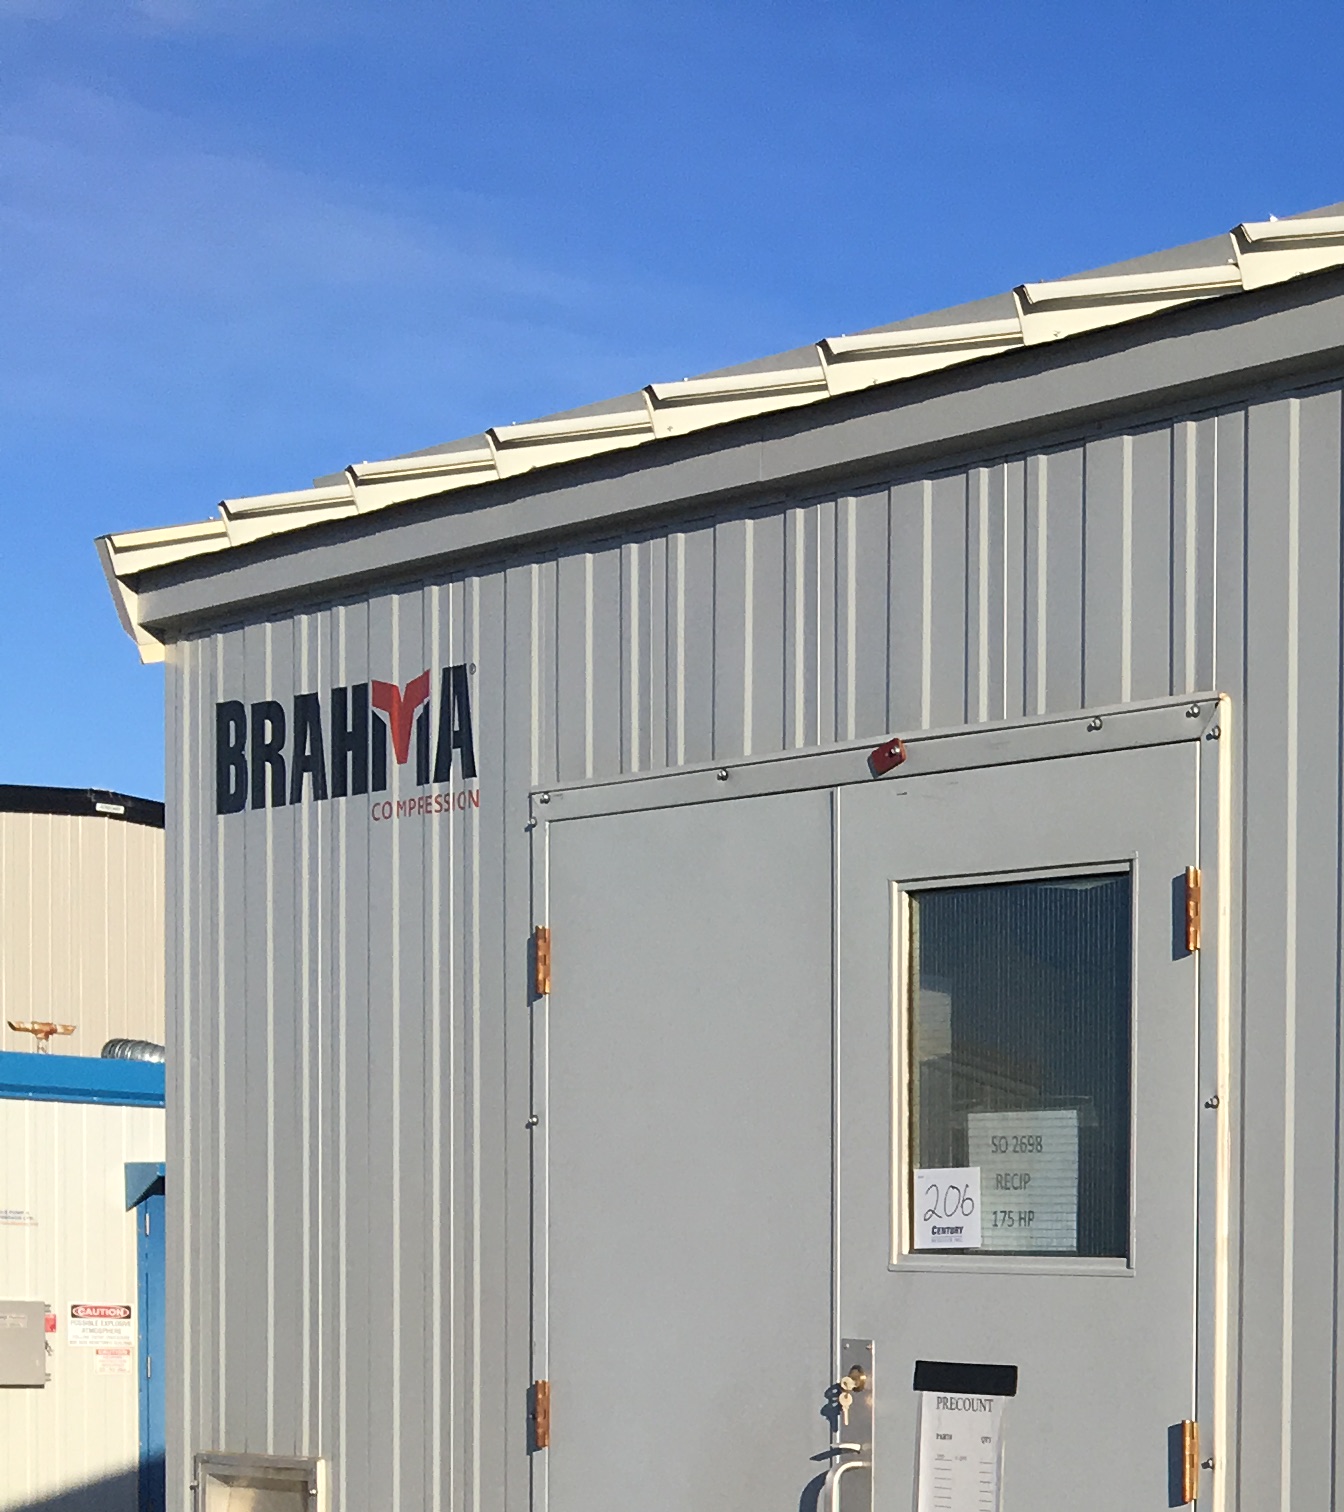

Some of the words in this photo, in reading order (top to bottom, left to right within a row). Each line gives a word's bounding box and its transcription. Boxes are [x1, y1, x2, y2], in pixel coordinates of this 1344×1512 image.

[216, 663, 477, 816] BRAHMA
[371, 789, 480, 821] COMPRESSION
[1012, 1135, 1043, 1153] 2698
[995, 1173, 1031, 1190] RECIP
[923, 1183, 974, 1222] 206
[992, 1210, 1015, 1227] 175
[1018, 1210, 1035, 1227] HP
[931, 1225, 964, 1236] CENTURY
[77, 1307, 124, 1317] CAUTION
[936, 1396, 994, 1413] PRECOUNT
